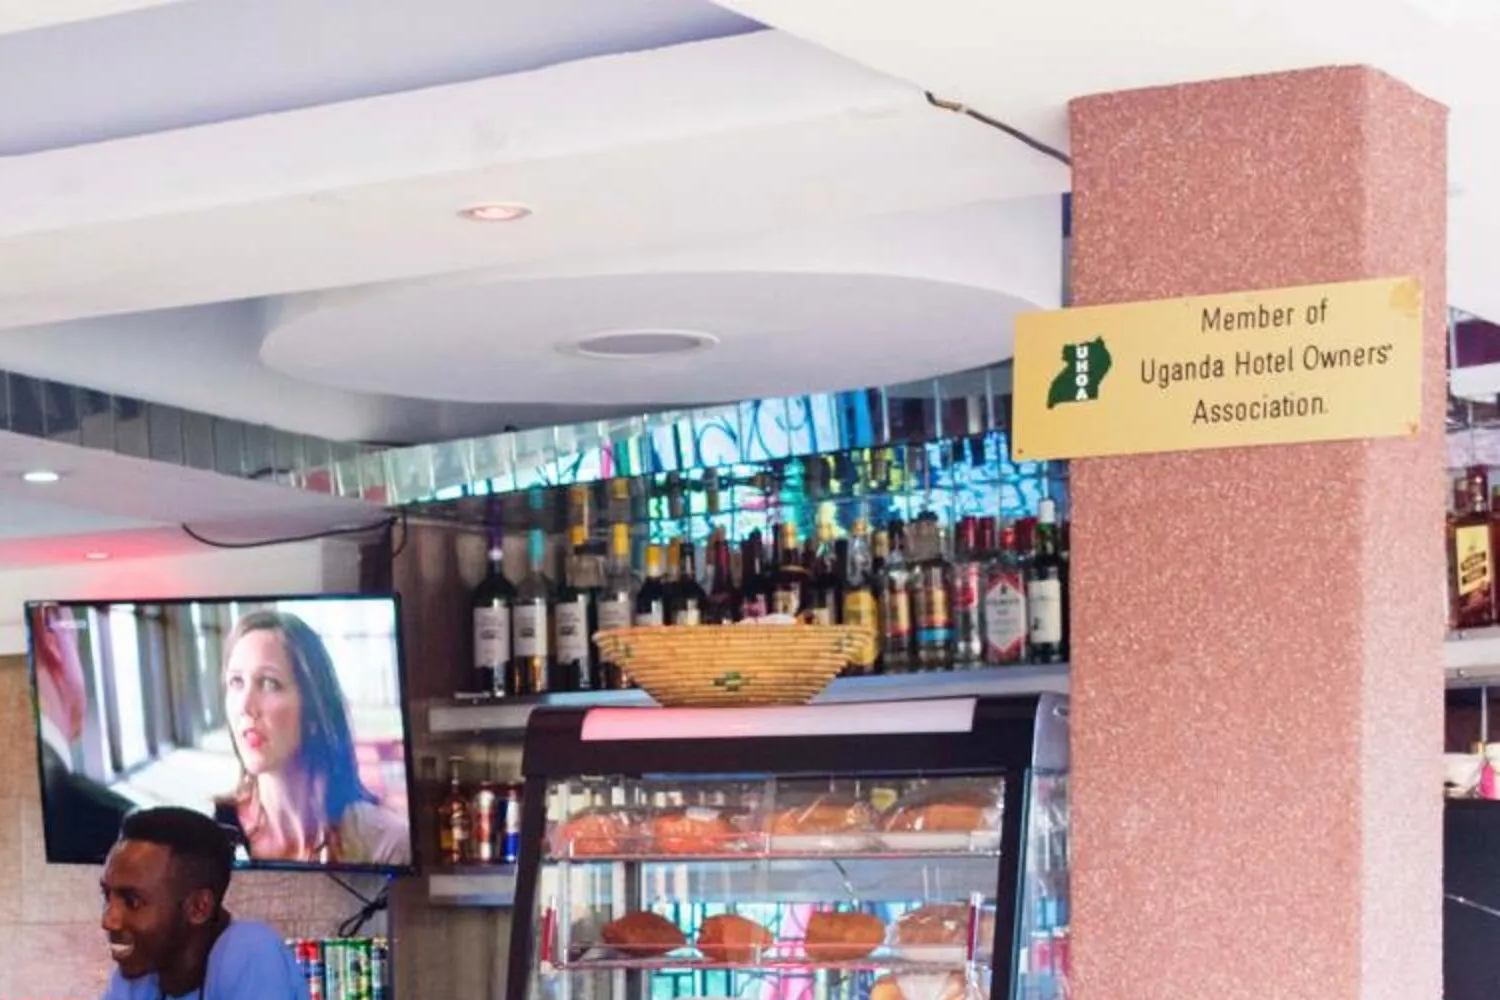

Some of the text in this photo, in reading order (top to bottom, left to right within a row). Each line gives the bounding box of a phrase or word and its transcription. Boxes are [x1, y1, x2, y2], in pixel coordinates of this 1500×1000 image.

[1201, 298, 1329, 333] Member of
[1075, 345, 1089, 401] UHOA
[1140, 354, 1225, 389] Uganda
[1235, 347, 1295, 377] Hotel
